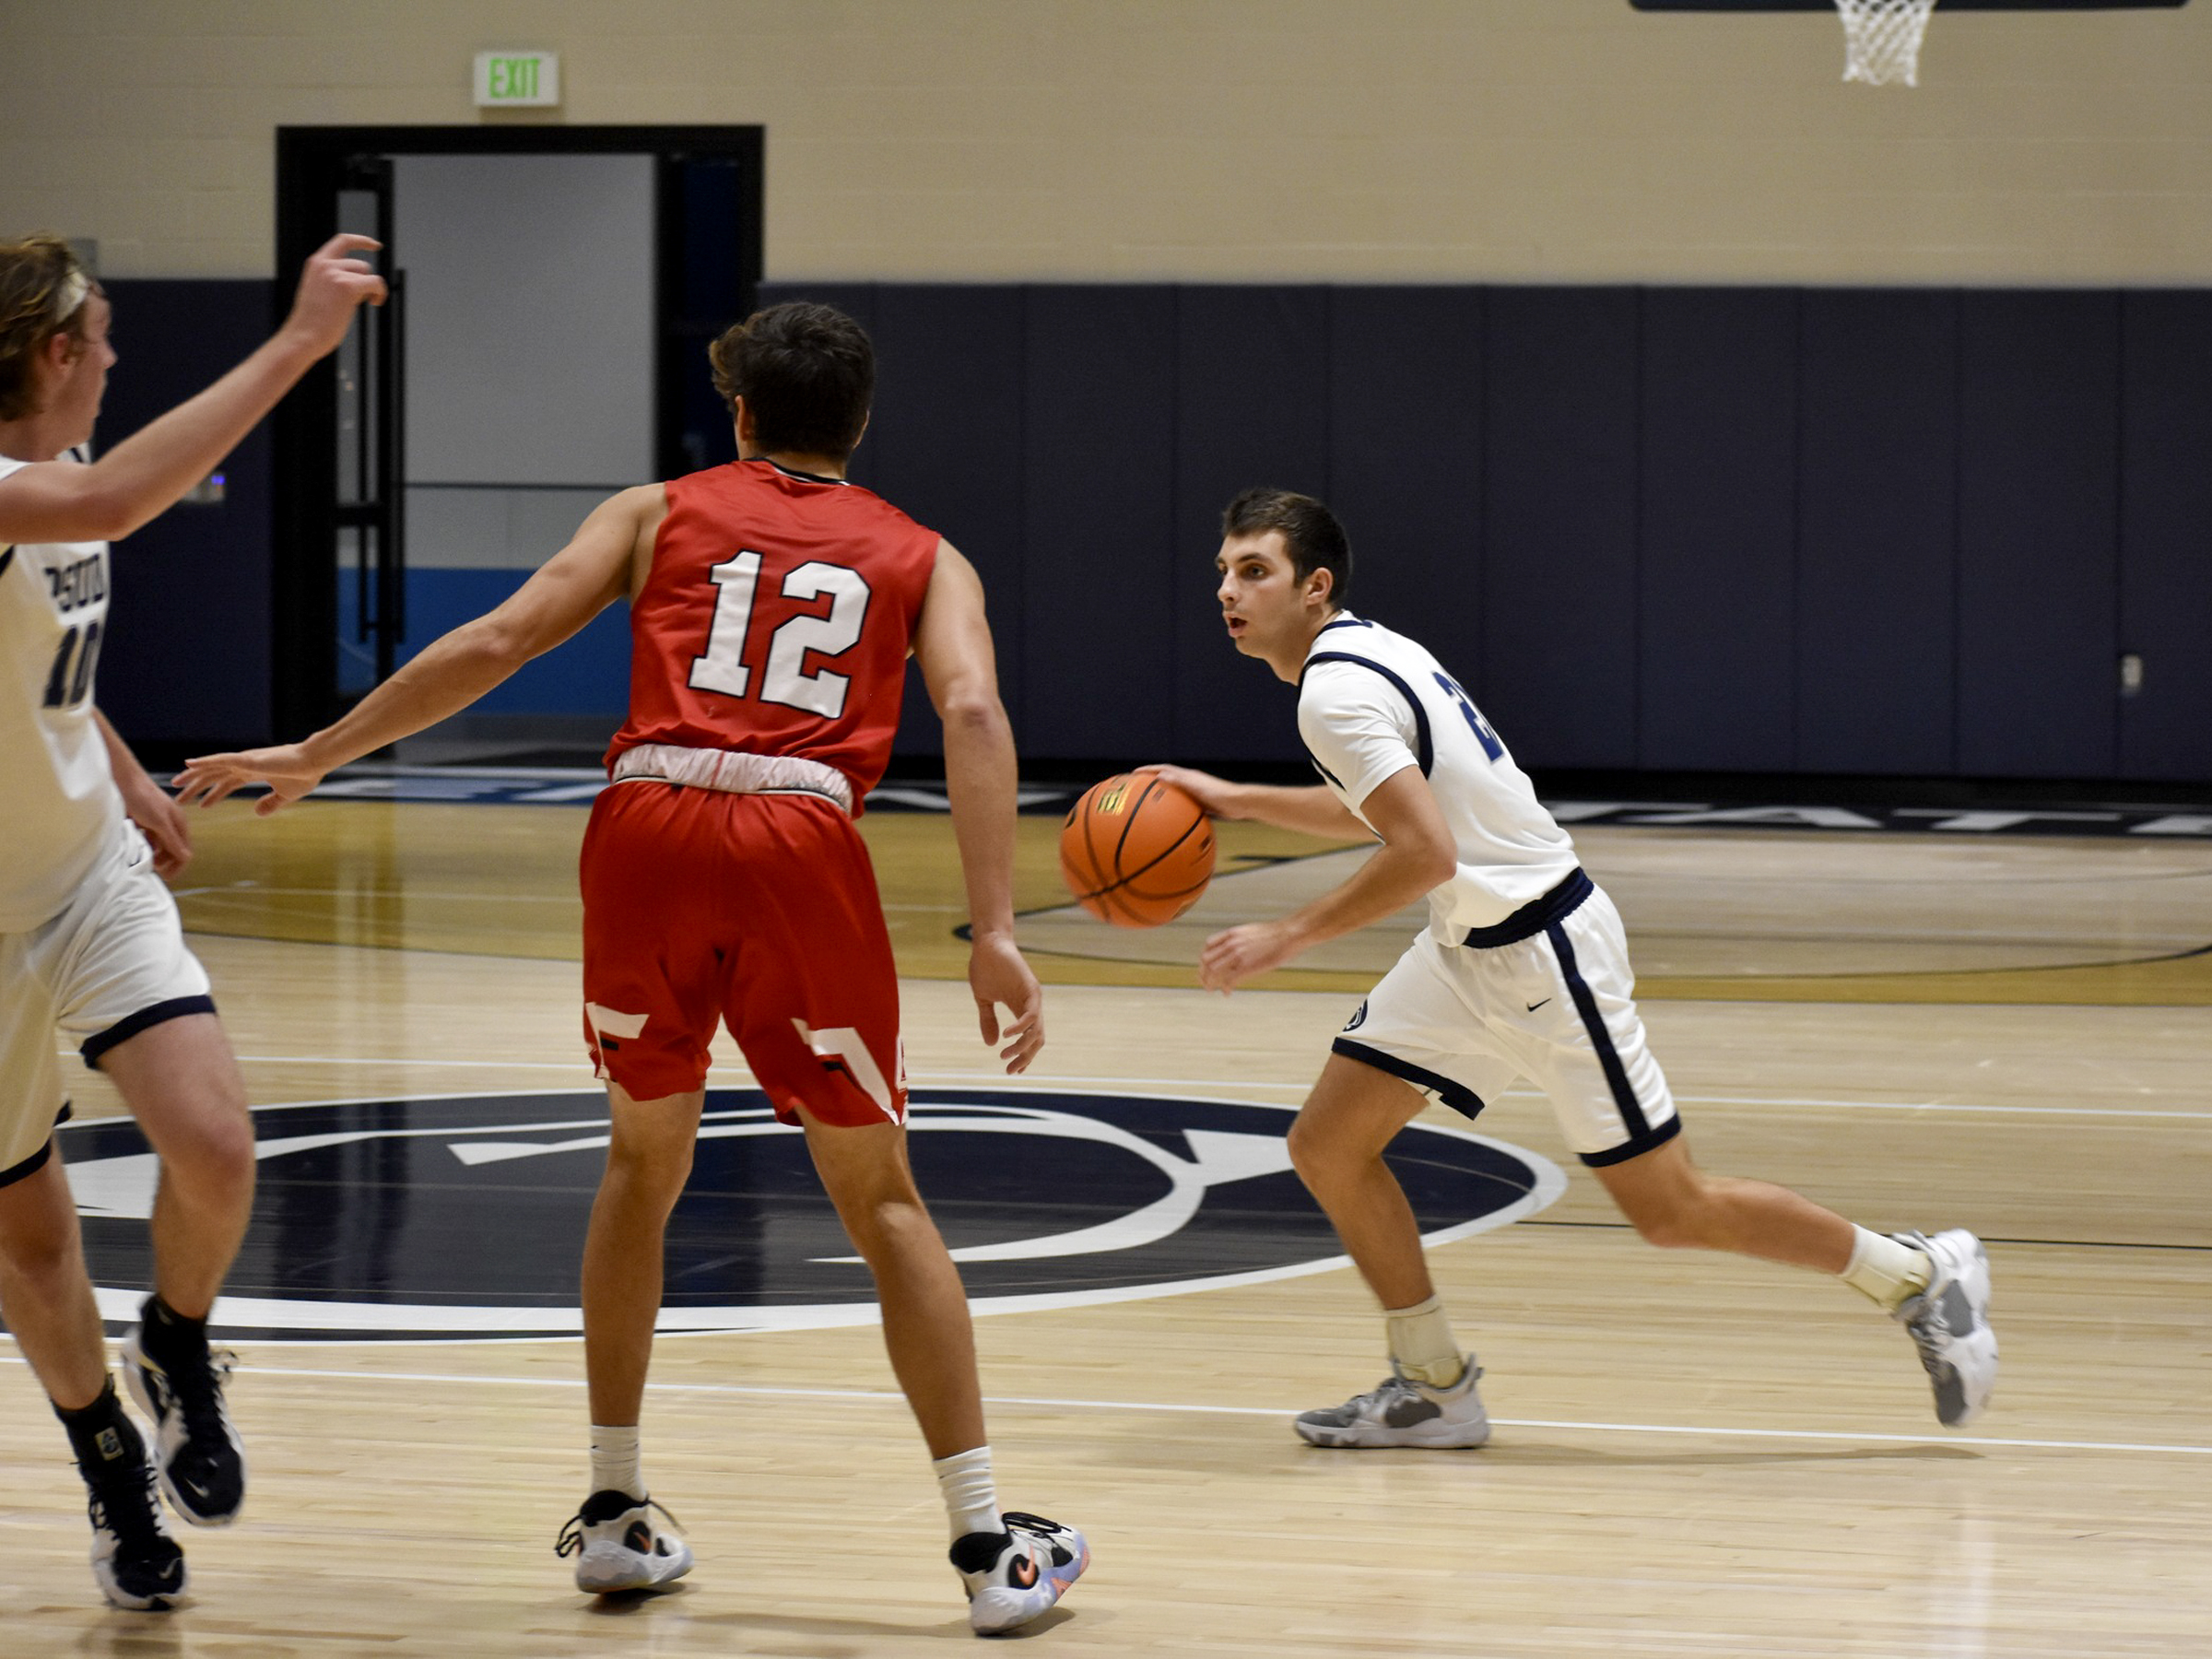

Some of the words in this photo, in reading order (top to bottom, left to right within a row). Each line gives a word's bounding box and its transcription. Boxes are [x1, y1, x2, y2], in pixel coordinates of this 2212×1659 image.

[489, 58, 540, 99] EXIT
[688, 548, 872, 720] 12
[1431, 666, 1505, 763] 2
